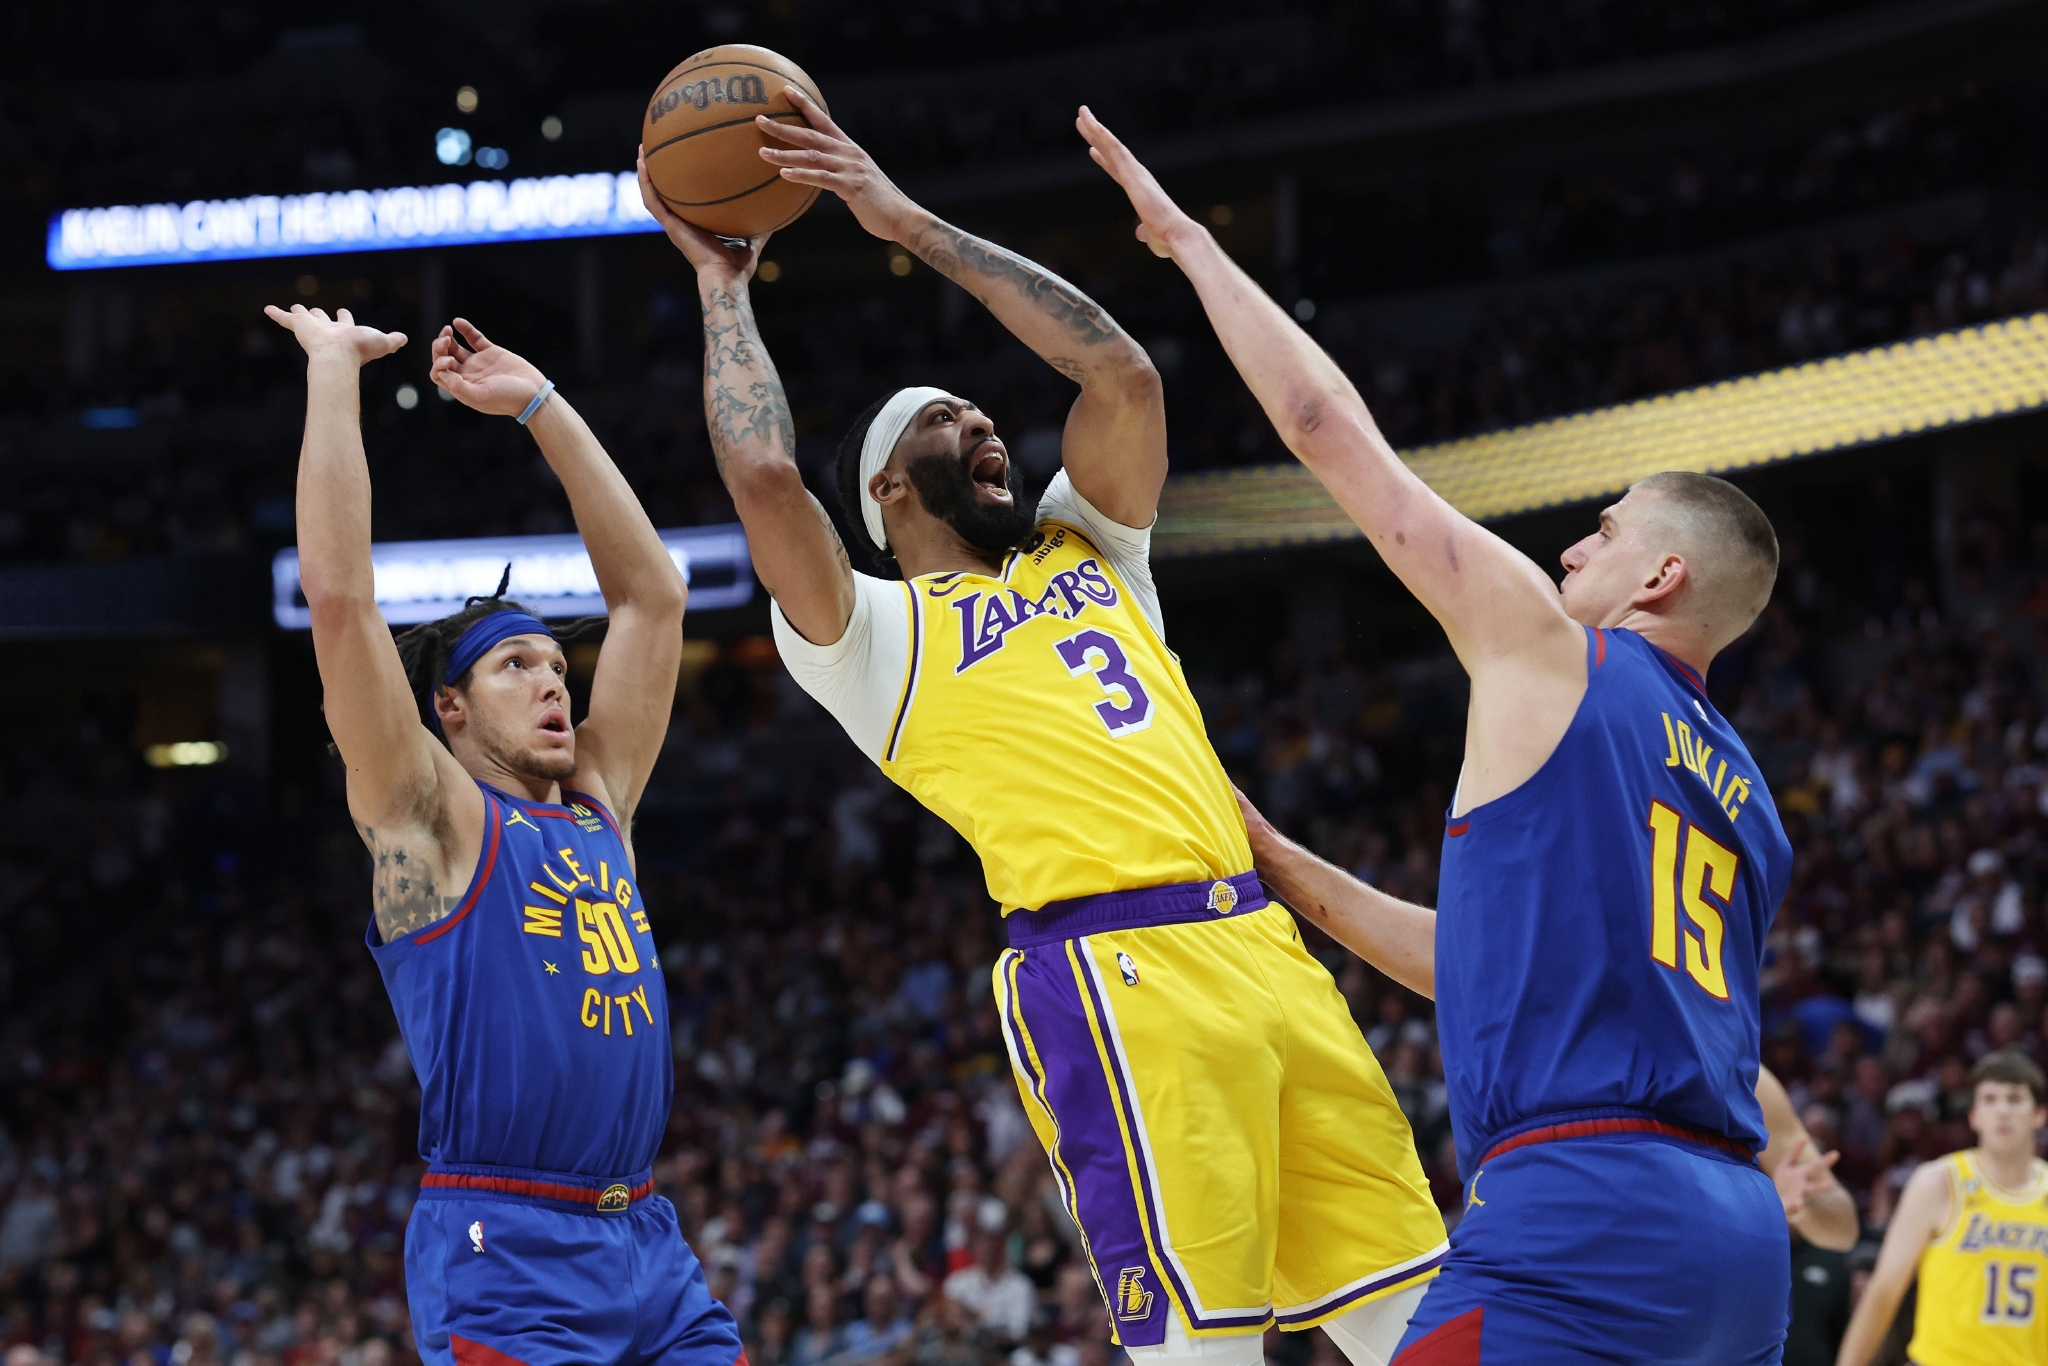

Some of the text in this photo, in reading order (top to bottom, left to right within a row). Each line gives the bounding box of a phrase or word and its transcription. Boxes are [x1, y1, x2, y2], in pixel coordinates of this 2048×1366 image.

[650, 73, 769, 125] Wilson
[1052, 627, 1156, 739] 3
[523, 847, 591, 938] MILE
[1647, 797, 1740, 1002] 15
[575, 896, 640, 975] 50
[580, 984, 654, 1036] CITY
[1982, 1261, 2038, 1327] 15
